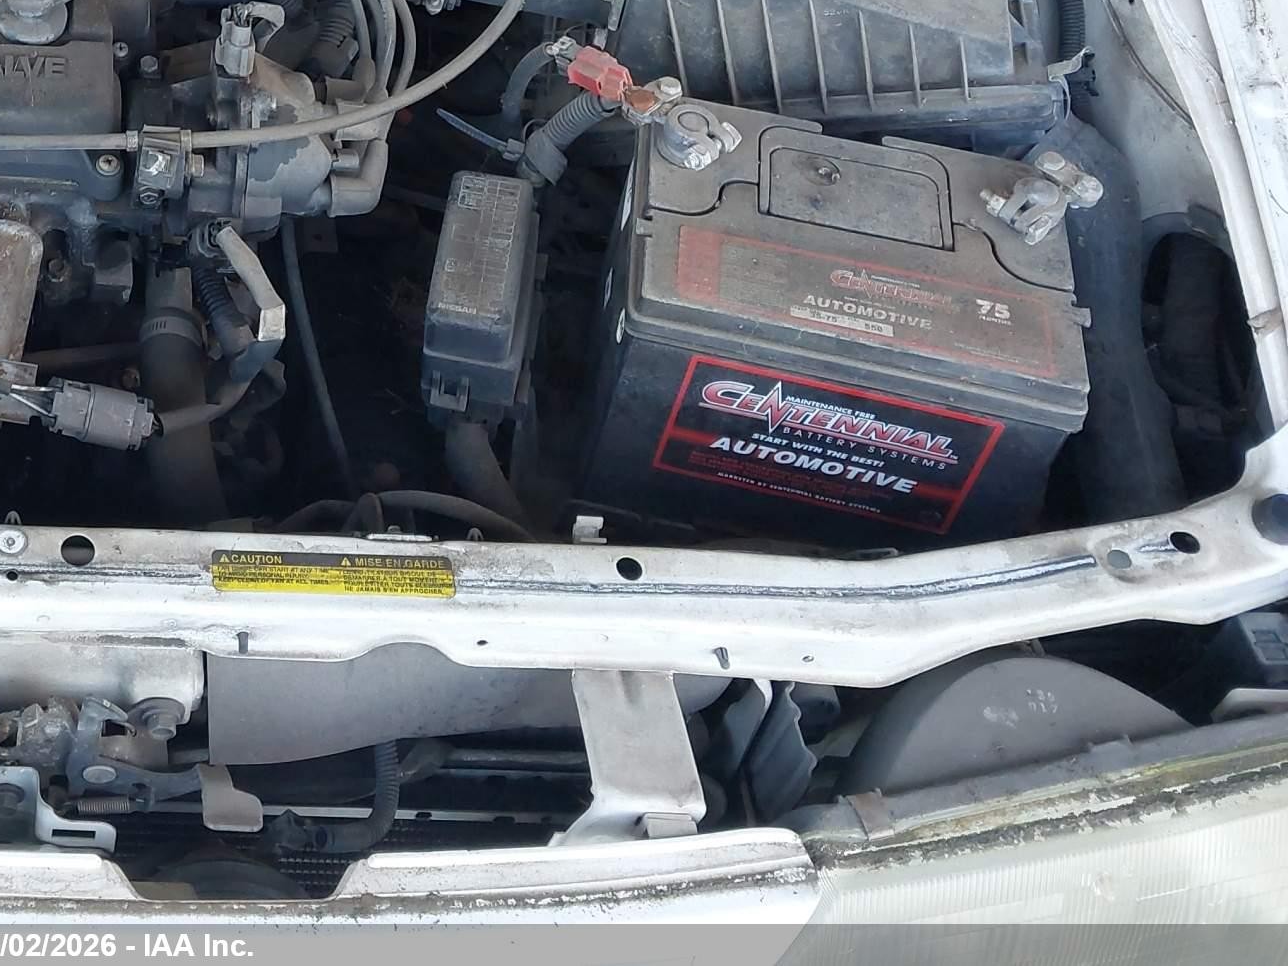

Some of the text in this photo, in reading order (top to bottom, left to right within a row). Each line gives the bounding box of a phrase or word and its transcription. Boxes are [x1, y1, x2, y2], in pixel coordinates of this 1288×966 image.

[803, 295, 933, 331] AUTOMOTIVE
[976, 299, 1011, 320] 75
[702, 380, 954, 458] CENTENNIAL
[785, 395, 876, 420] MAINTENANCE FREE
[709, 437, 918, 494] AUTOMOTIVE
[752, 433, 885, 468] START WITH THE BEST!
[783, 426, 947, 471] BATTERY SYSTEMS
[231, 554, 282, 564] CAUTION
[355, 557, 445, 569] MISE EN GARDE
